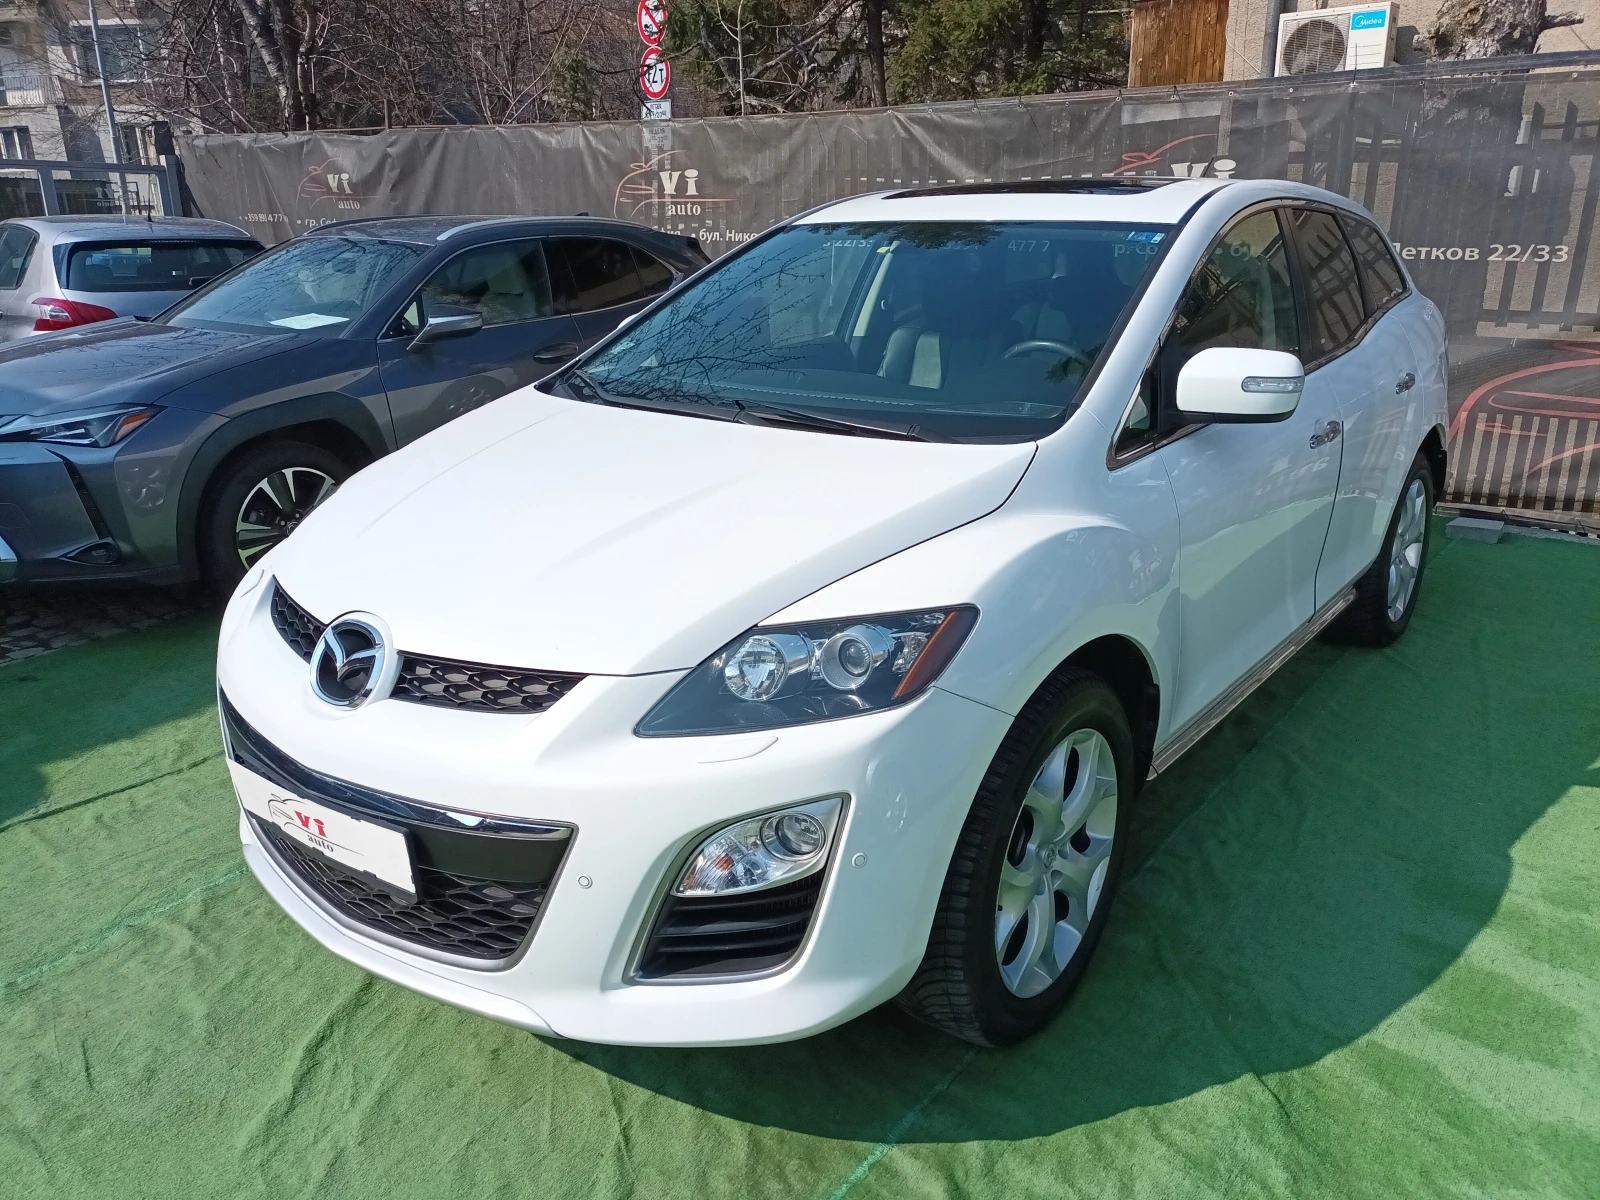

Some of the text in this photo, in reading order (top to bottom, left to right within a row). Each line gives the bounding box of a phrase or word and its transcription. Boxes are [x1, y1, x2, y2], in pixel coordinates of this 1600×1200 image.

[338, 199, 360, 210] auto
[668, 202, 701, 216] auto
[699, 229, 723, 244] бул.
[1487, 243, 1569, 263] 22/33
[307, 834, 334, 853] auto
